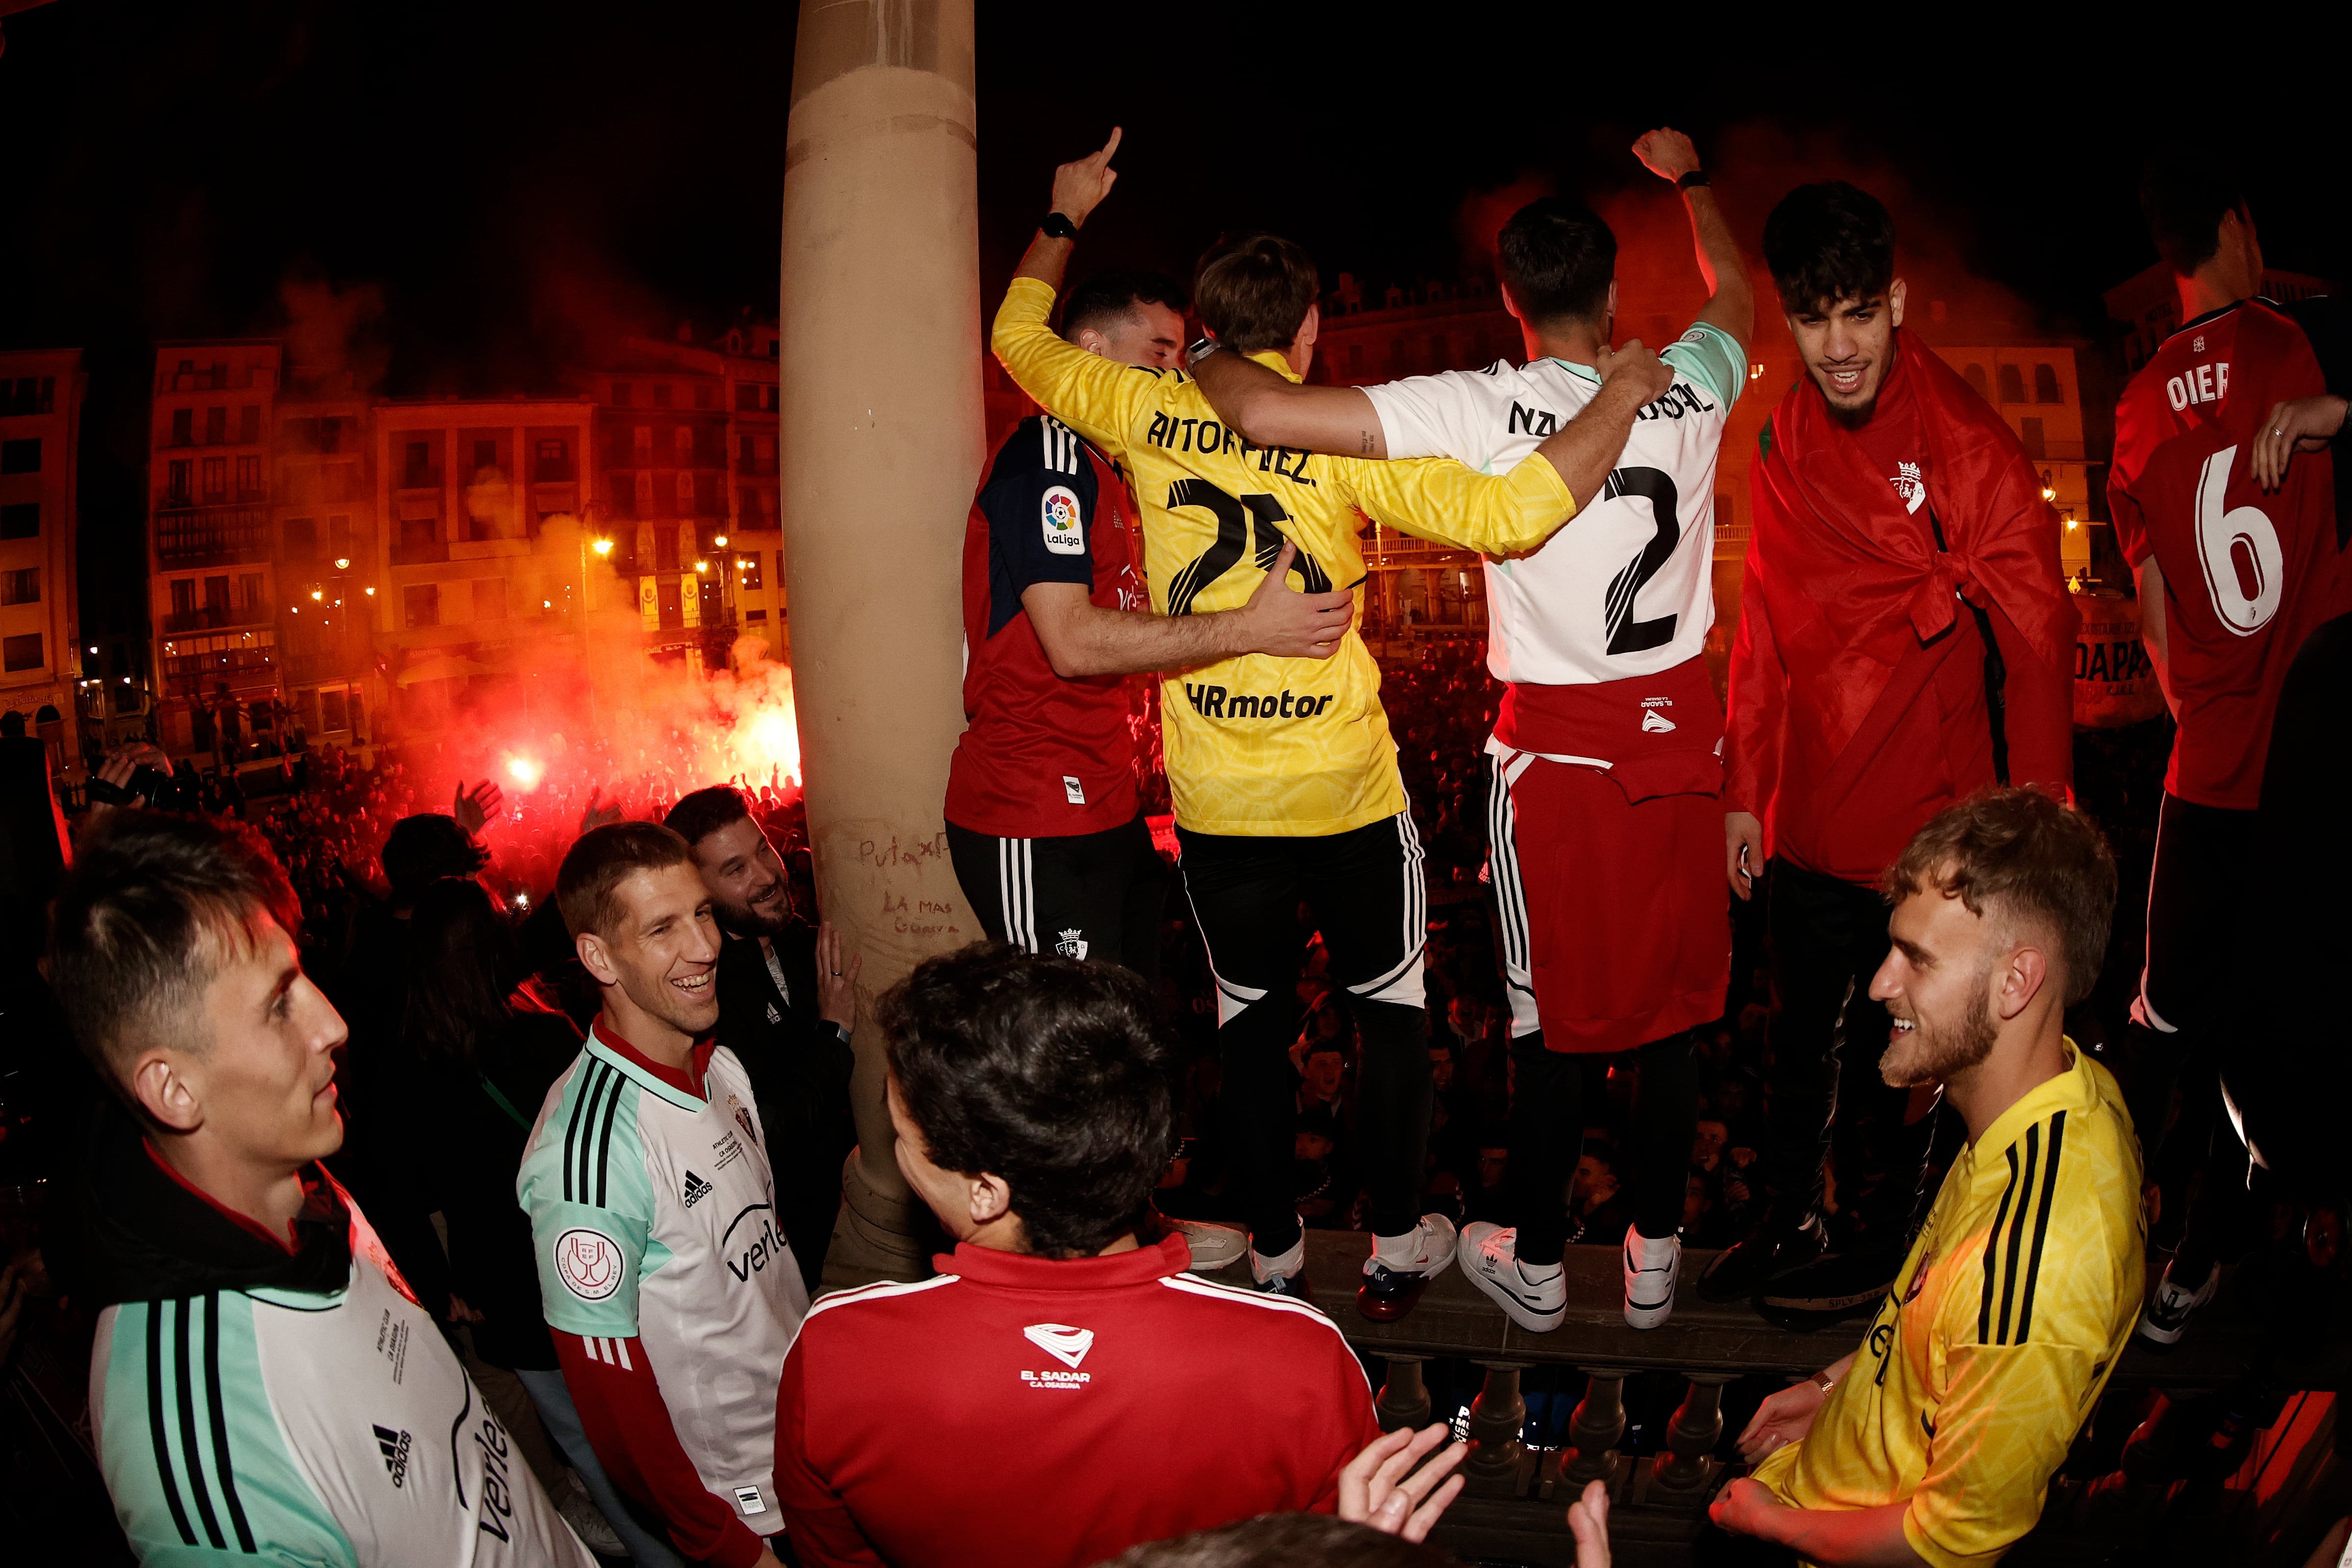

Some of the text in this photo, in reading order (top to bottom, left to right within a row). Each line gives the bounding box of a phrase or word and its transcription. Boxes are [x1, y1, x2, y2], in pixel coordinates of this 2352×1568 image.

[1047, 534, 1079, 547] LaLiga
[2194, 444, 2284, 637] 6
[1604, 467, 1678, 655] 2
[684, 1180, 714, 1209] adidas
[561, 1257, 571, 1280] COPA
[572, 1281, 582, 1291] DE
[1481, 1266, 1496, 1275] adidas
[1020, 1370, 1092, 1383] EL SADAR
[392, 1430, 413, 1490] adidas
